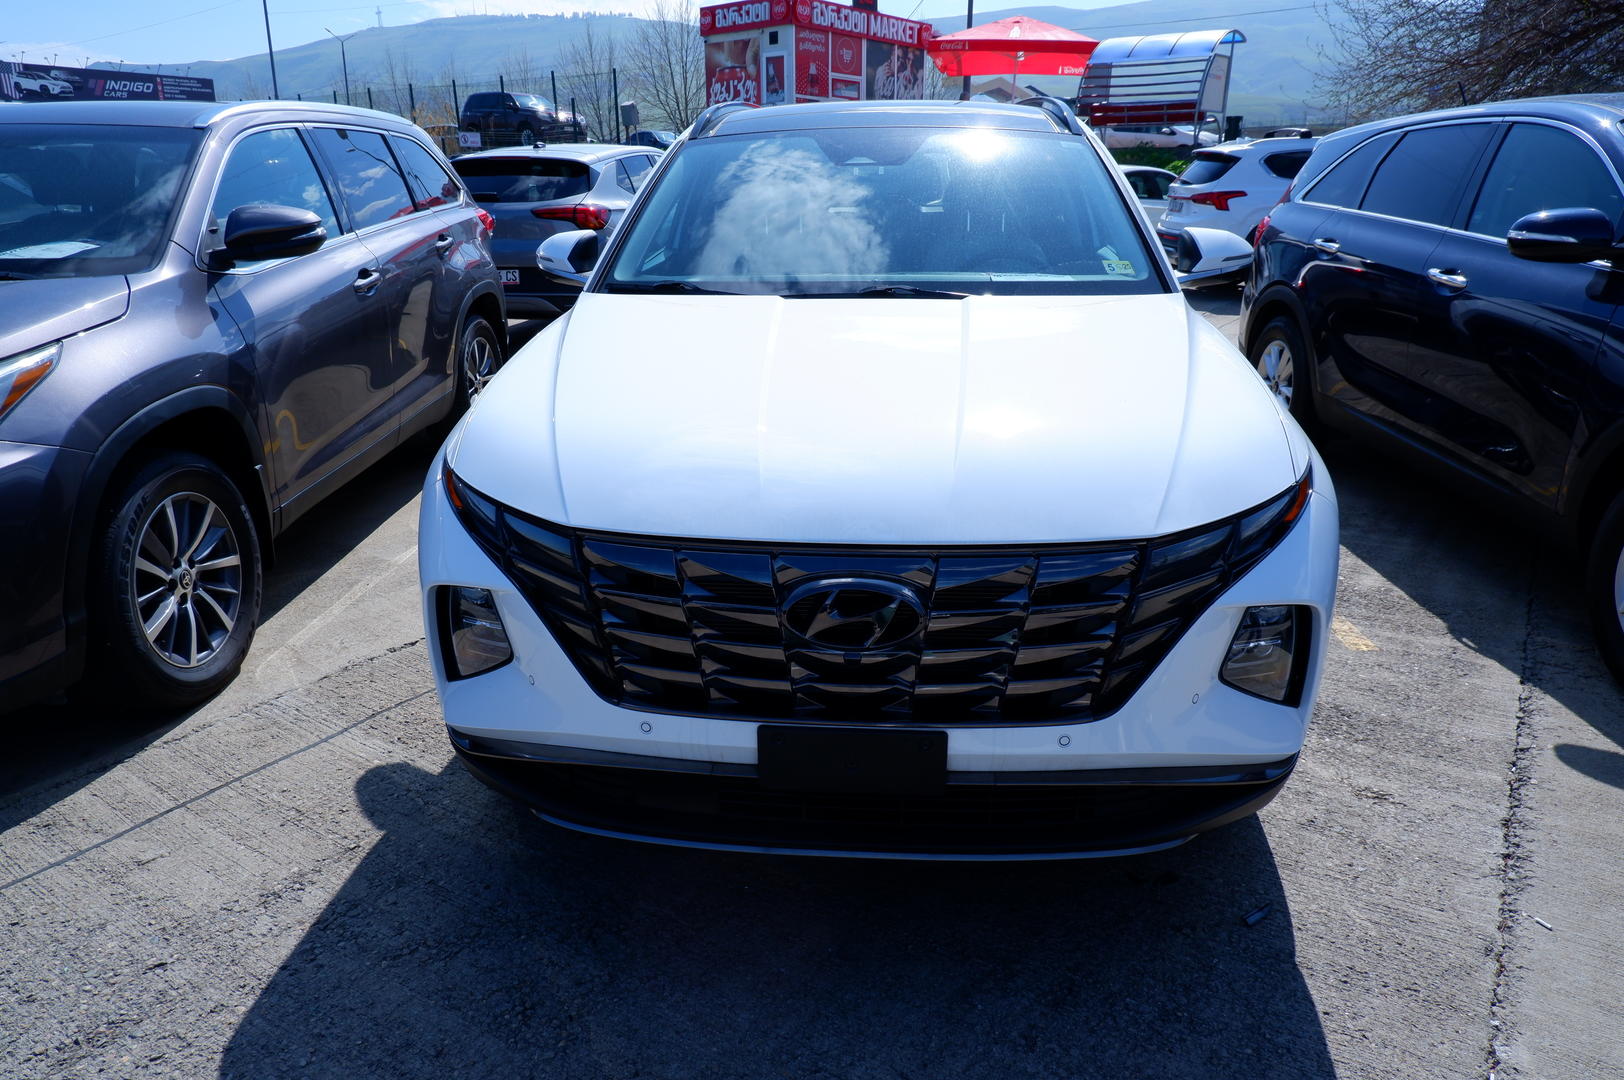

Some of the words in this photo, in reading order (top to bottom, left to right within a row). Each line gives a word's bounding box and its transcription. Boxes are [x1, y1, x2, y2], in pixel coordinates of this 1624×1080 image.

[870, 14, 920, 44] MARKET
[106, 80, 153, 93] INDIGO
[104, 90, 128, 98] CARS
[1108, 264, 1116, 272] 5
[506, 271, 517, 282] CS
